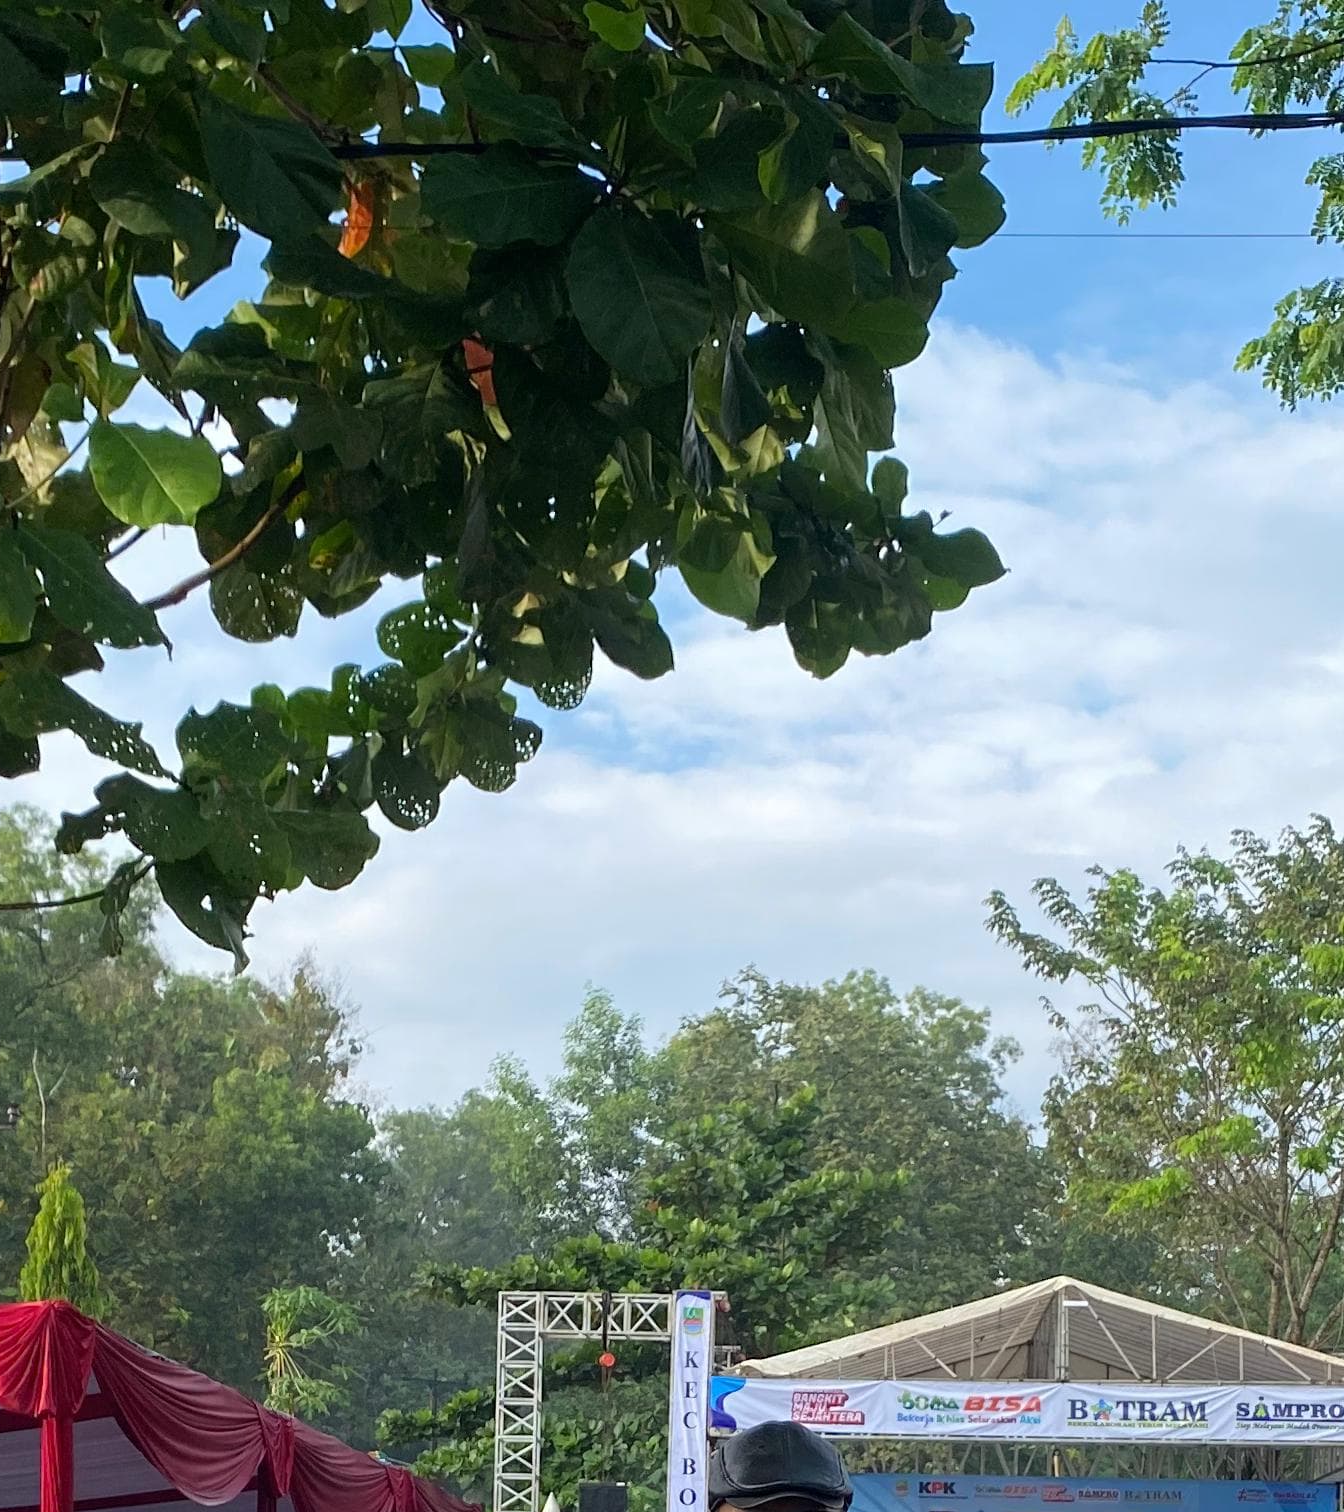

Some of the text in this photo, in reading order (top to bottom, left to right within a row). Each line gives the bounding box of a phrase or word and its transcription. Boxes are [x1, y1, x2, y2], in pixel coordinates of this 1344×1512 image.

[683, 1350, 699, 1430] KEC
[963, 1395, 1041, 1412] BISA
[792, 1411, 863, 1423] SEJAHTERA
[918, 1481, 957, 1494] KPK
